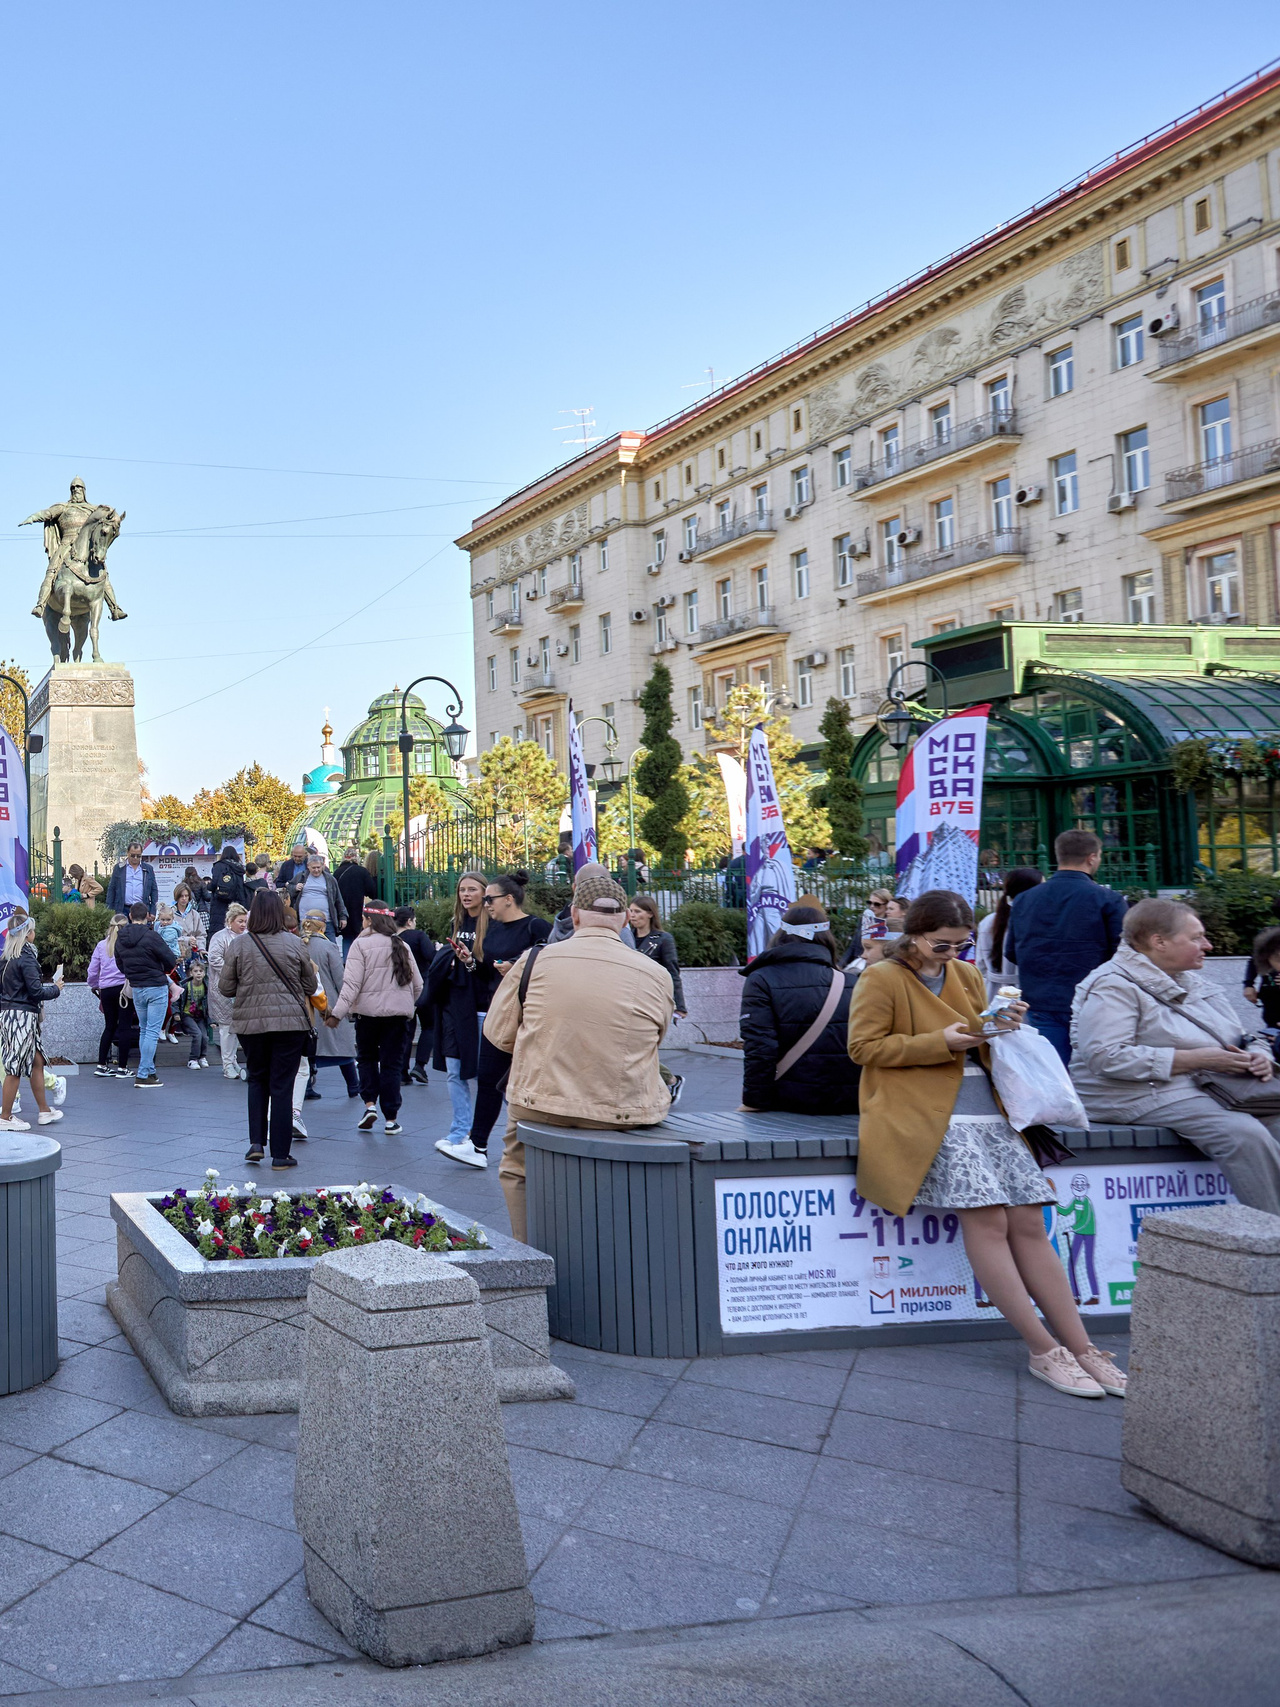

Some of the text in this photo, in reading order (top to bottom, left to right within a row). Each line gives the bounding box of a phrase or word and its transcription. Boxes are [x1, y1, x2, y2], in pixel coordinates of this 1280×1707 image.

[1104, 1169, 1235, 1200] ВЫИГРАЙ СВО
[723, 1189, 835, 1220] ГОЛОСУЕМ
[724, 1219, 812, 1255] ОНЛАЙН
[808, 1268, 836, 1279] MOS.RU
